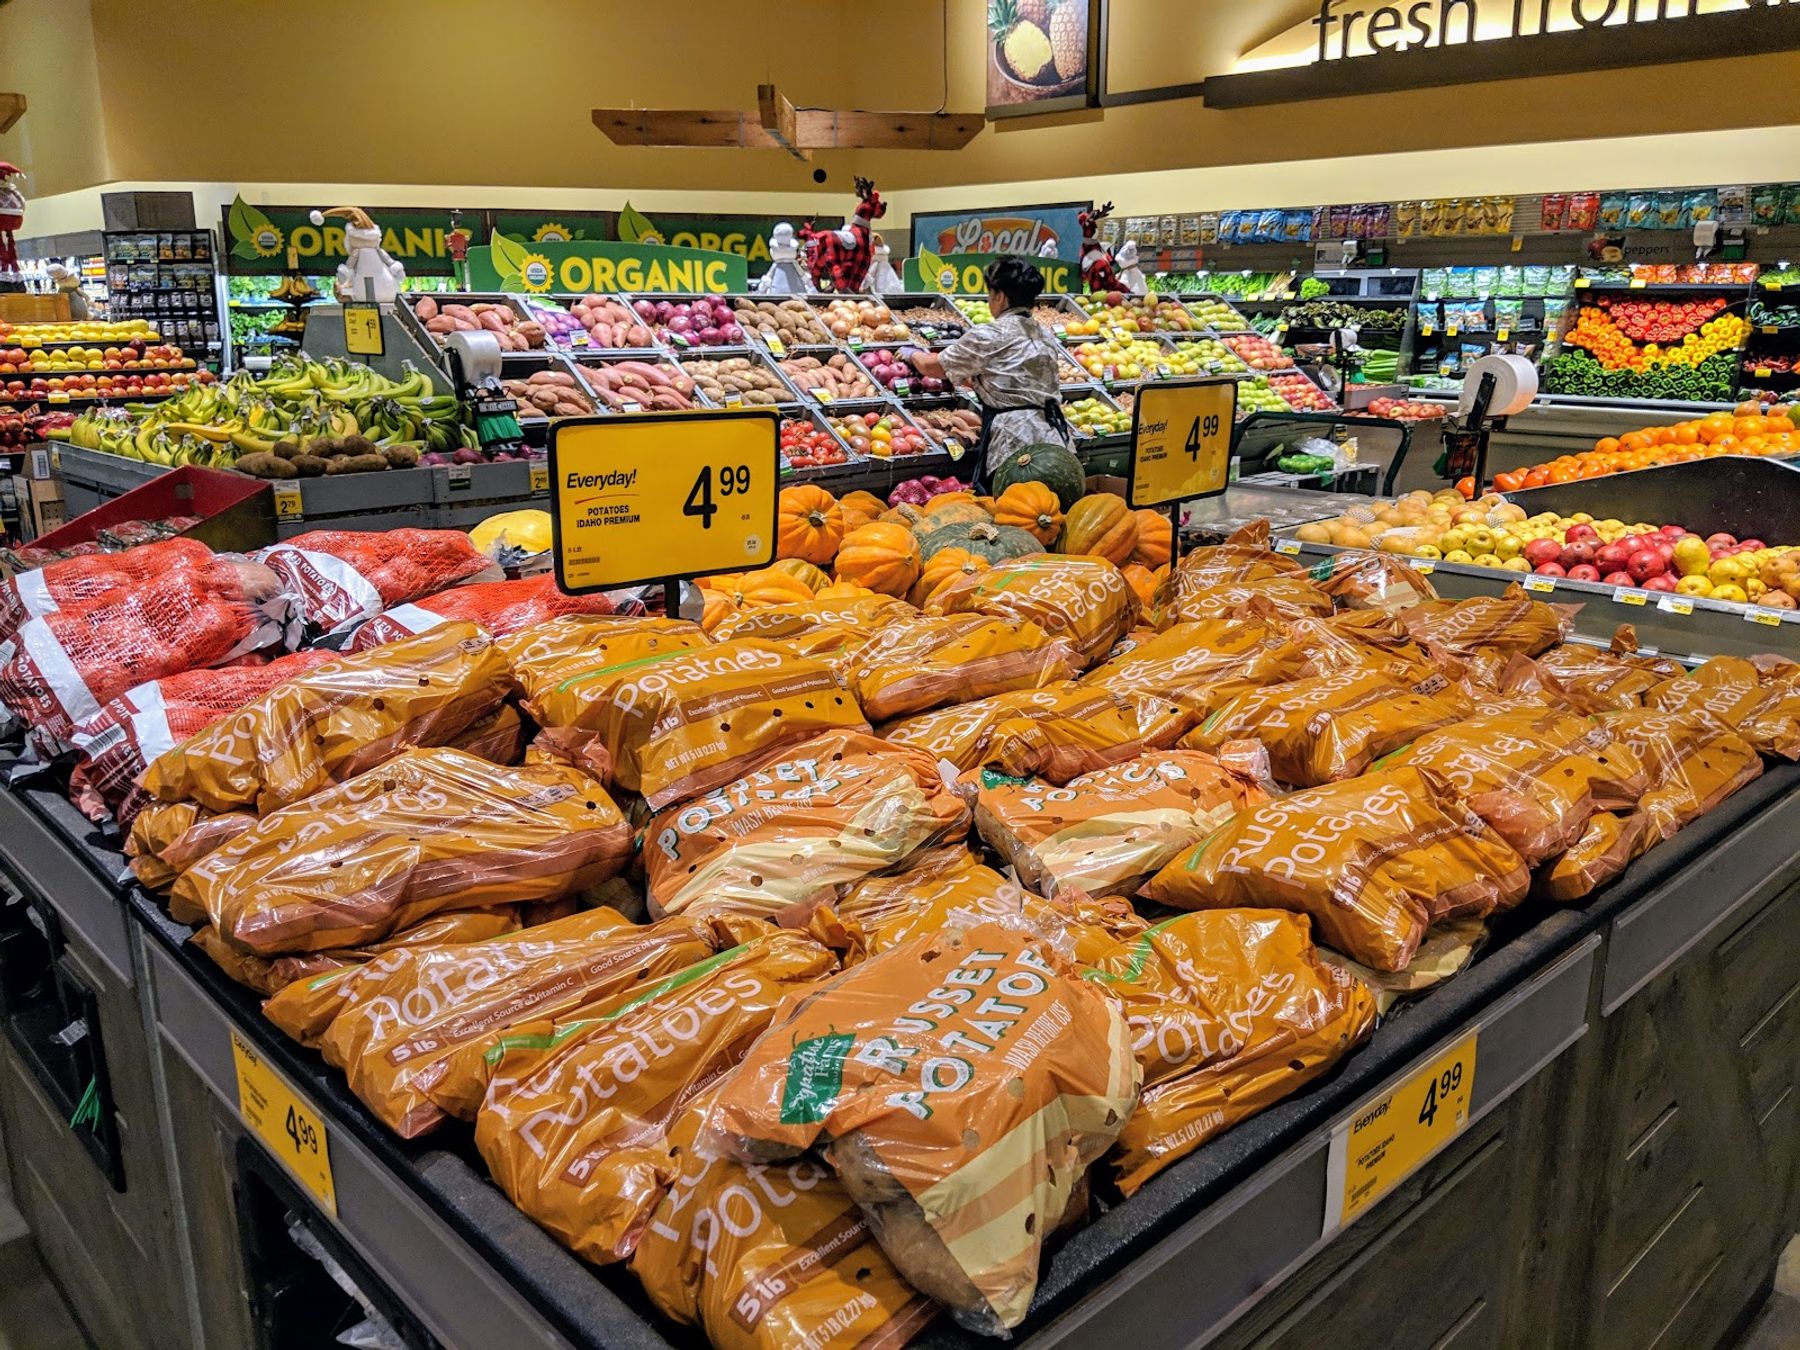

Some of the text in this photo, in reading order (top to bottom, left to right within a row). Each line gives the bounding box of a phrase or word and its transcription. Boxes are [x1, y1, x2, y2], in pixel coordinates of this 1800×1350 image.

[1312, 0, 1477, 64] fresh
[290, 226, 473, 258] ORANI
[951, 217, 1044, 255] Local
[1624, 243, 1670, 256] peppers
[560, 256, 729, 294] ORGANIC
[567, 469, 637, 490] Everyday!
[576, 514, 640, 528] IDAHO PREMIUM
[587, 504, 629, 516] POTATOES
[730, 806, 763, 838] WASH
[590, 940, 651, 976] Good Source of
[392, 1045, 414, 1062] 5
[414, 1037, 438, 1055] lb
[452, 1016, 495, 1039] Excellent
[494, 1001, 525, 1021] Source
[533, 981, 565, 1003] Vitamin
[566, 977, 575, 987] C
[854, 948, 1008, 1076] RUSSET
[1001, 998, 1074, 1071] WASH BEFORE USE
[686, 1064, 724, 1096] Vitamin C
[1353, 1095, 1393, 1135] Everyday!
[568, 1155, 591, 1180] 5
[1356, 1143, 1381, 1168] POTATOES
[737, 1294, 762, 1324] 5
[754, 1276, 788, 1299] lb
[798, 1238, 841, 1273] Excellent
[822, 1314, 845, 1338] LB
[834, 1299, 865, 1329] (2.27
[816, 1324, 833, 1343] 5
